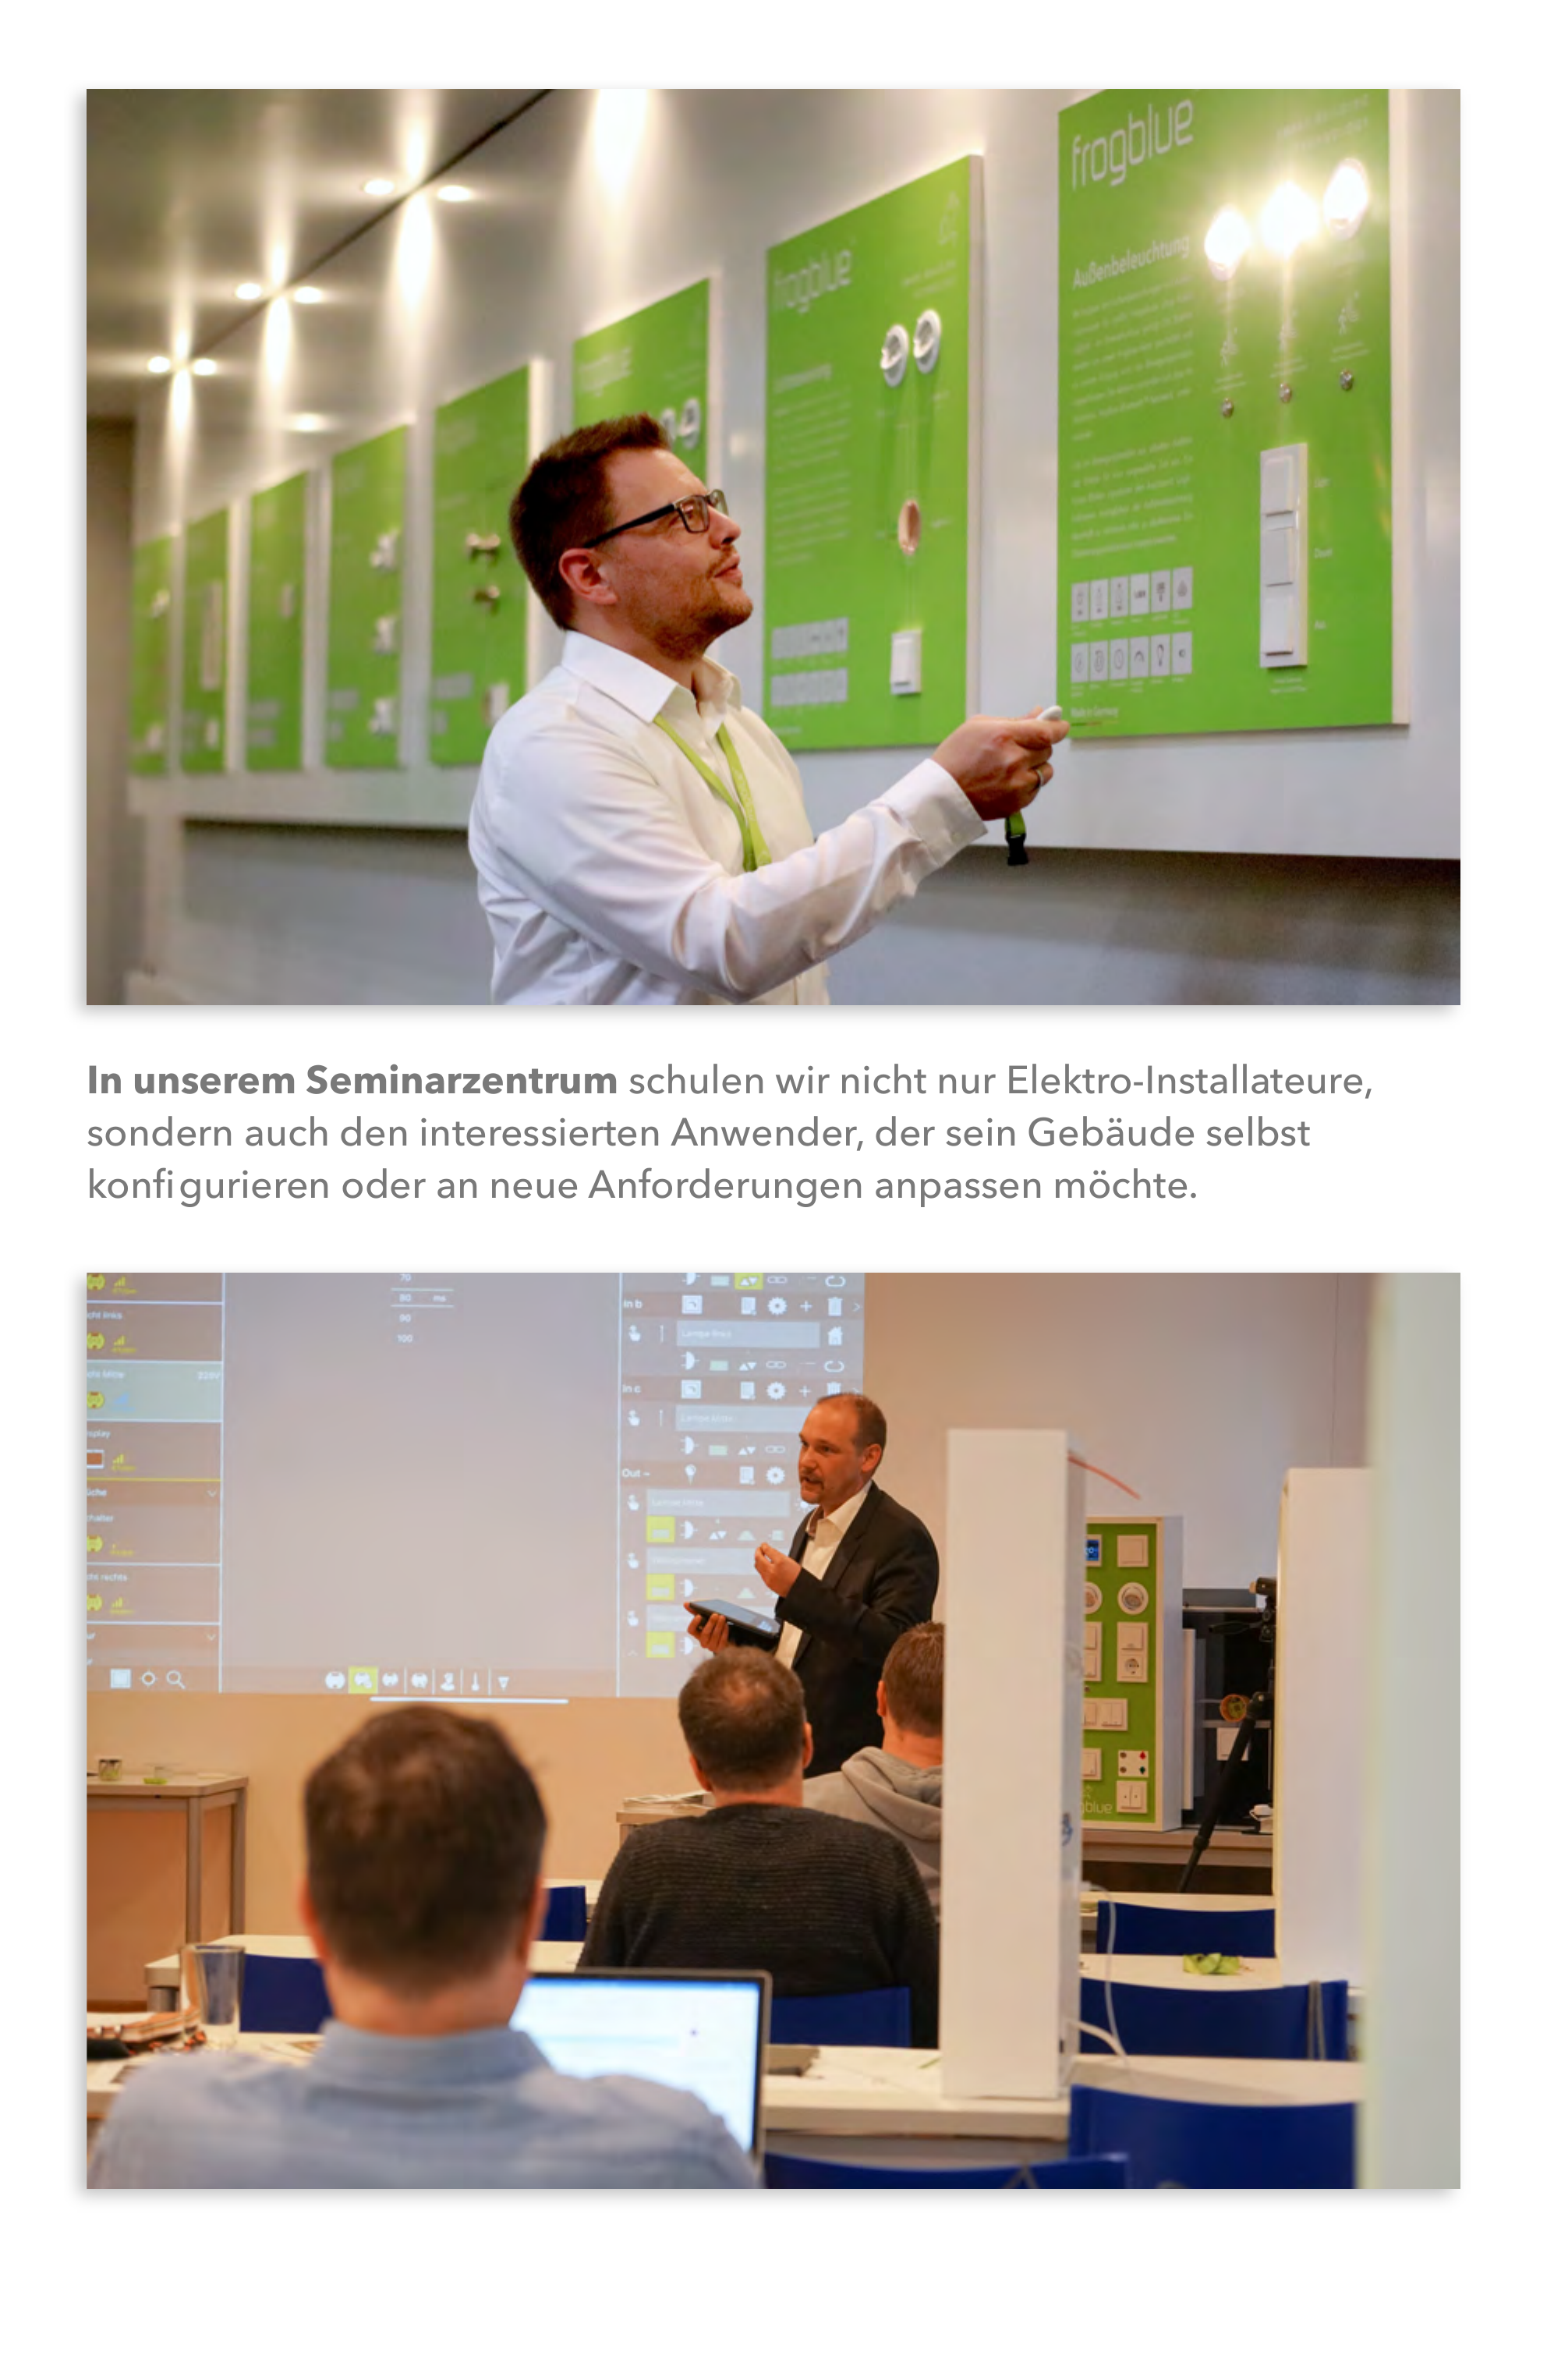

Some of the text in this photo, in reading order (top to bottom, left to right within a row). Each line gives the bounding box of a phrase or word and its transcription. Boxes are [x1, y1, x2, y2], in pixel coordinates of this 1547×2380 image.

[1071, 99, 1194, 191] frogblue
[1072, 235, 1190, 289] Außenbeleuchtung
[623, 1299, 643, 1309] In b
[397, 1333, 413, 1343] 100
[622, 1384, 633, 1394] In
[622, 1468, 641, 1478] Out
